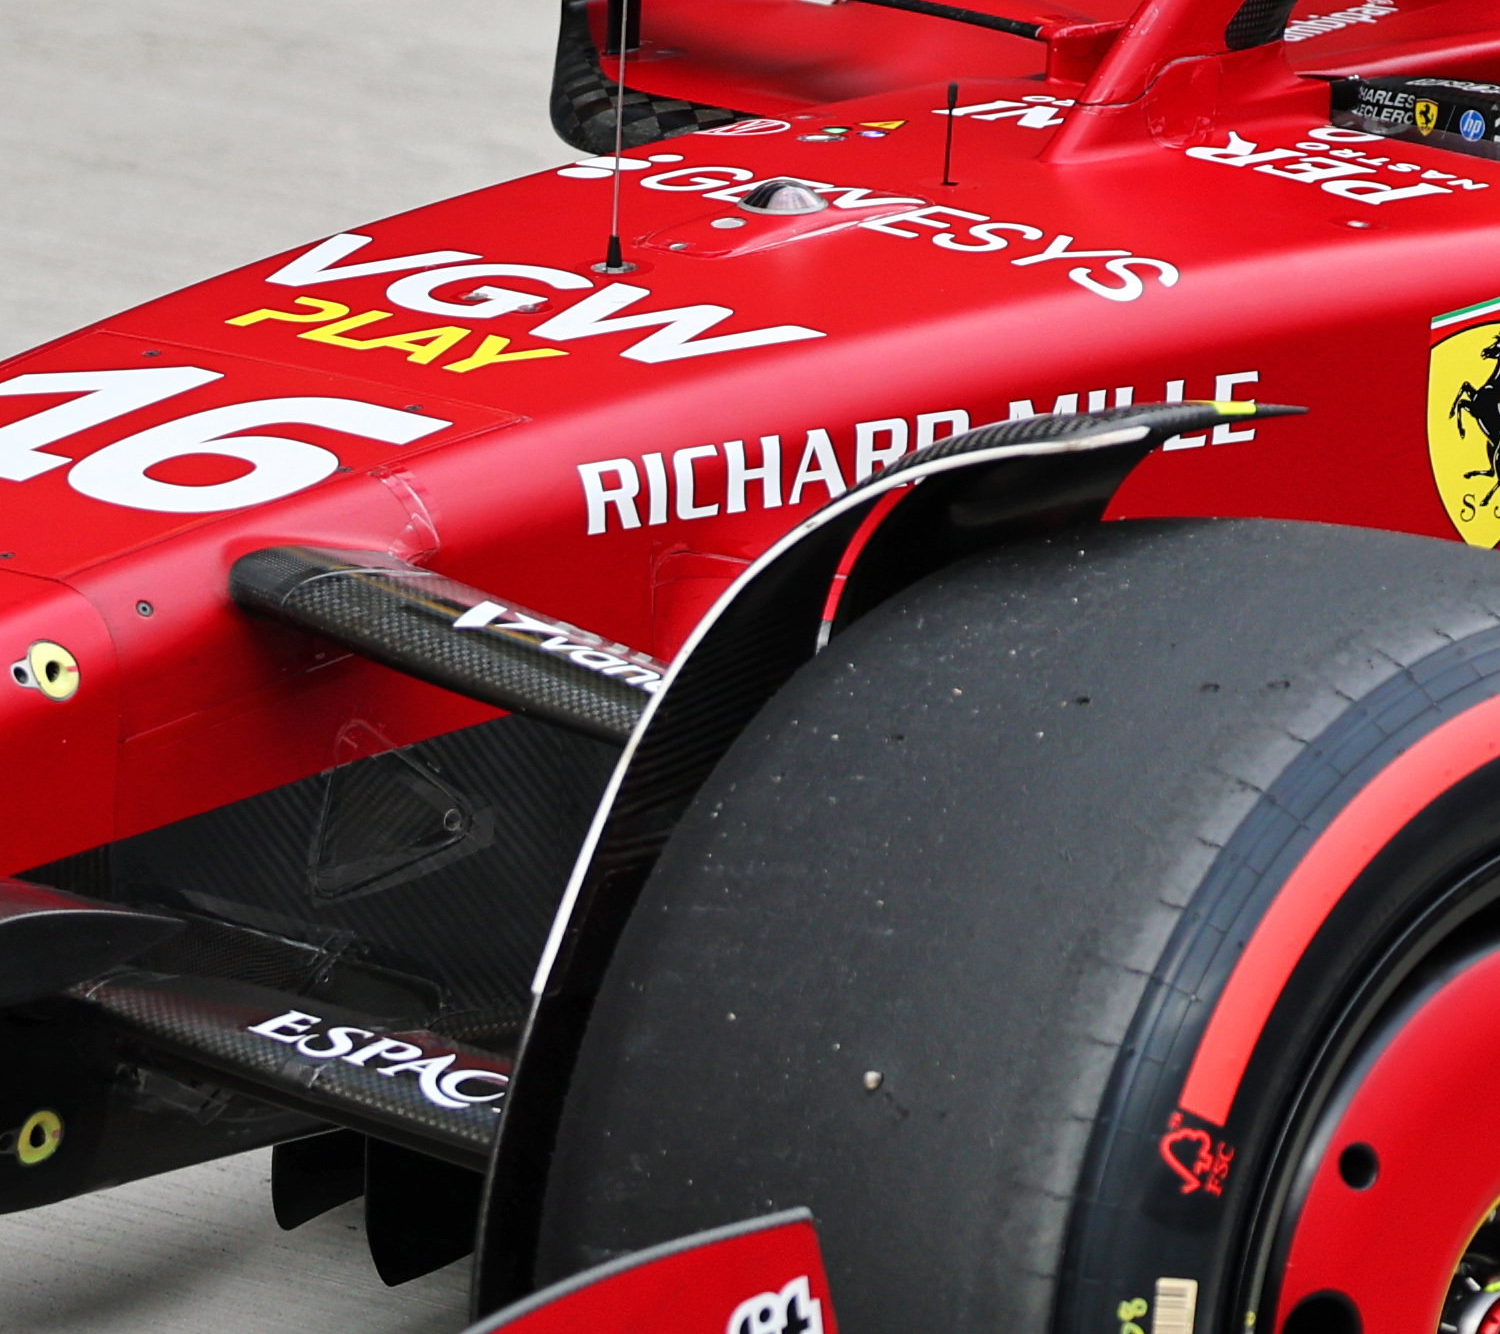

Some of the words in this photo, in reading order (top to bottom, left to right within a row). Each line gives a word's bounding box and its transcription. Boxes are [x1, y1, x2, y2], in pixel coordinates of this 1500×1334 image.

[1460, 110, 1486, 142] hp
[1295, 140, 1490, 192] NASTRO
[265, 233, 828, 364] VGW
[223, 296, 571, 374] PLAY
[1203, 1140, 1237, 1197] FSC
